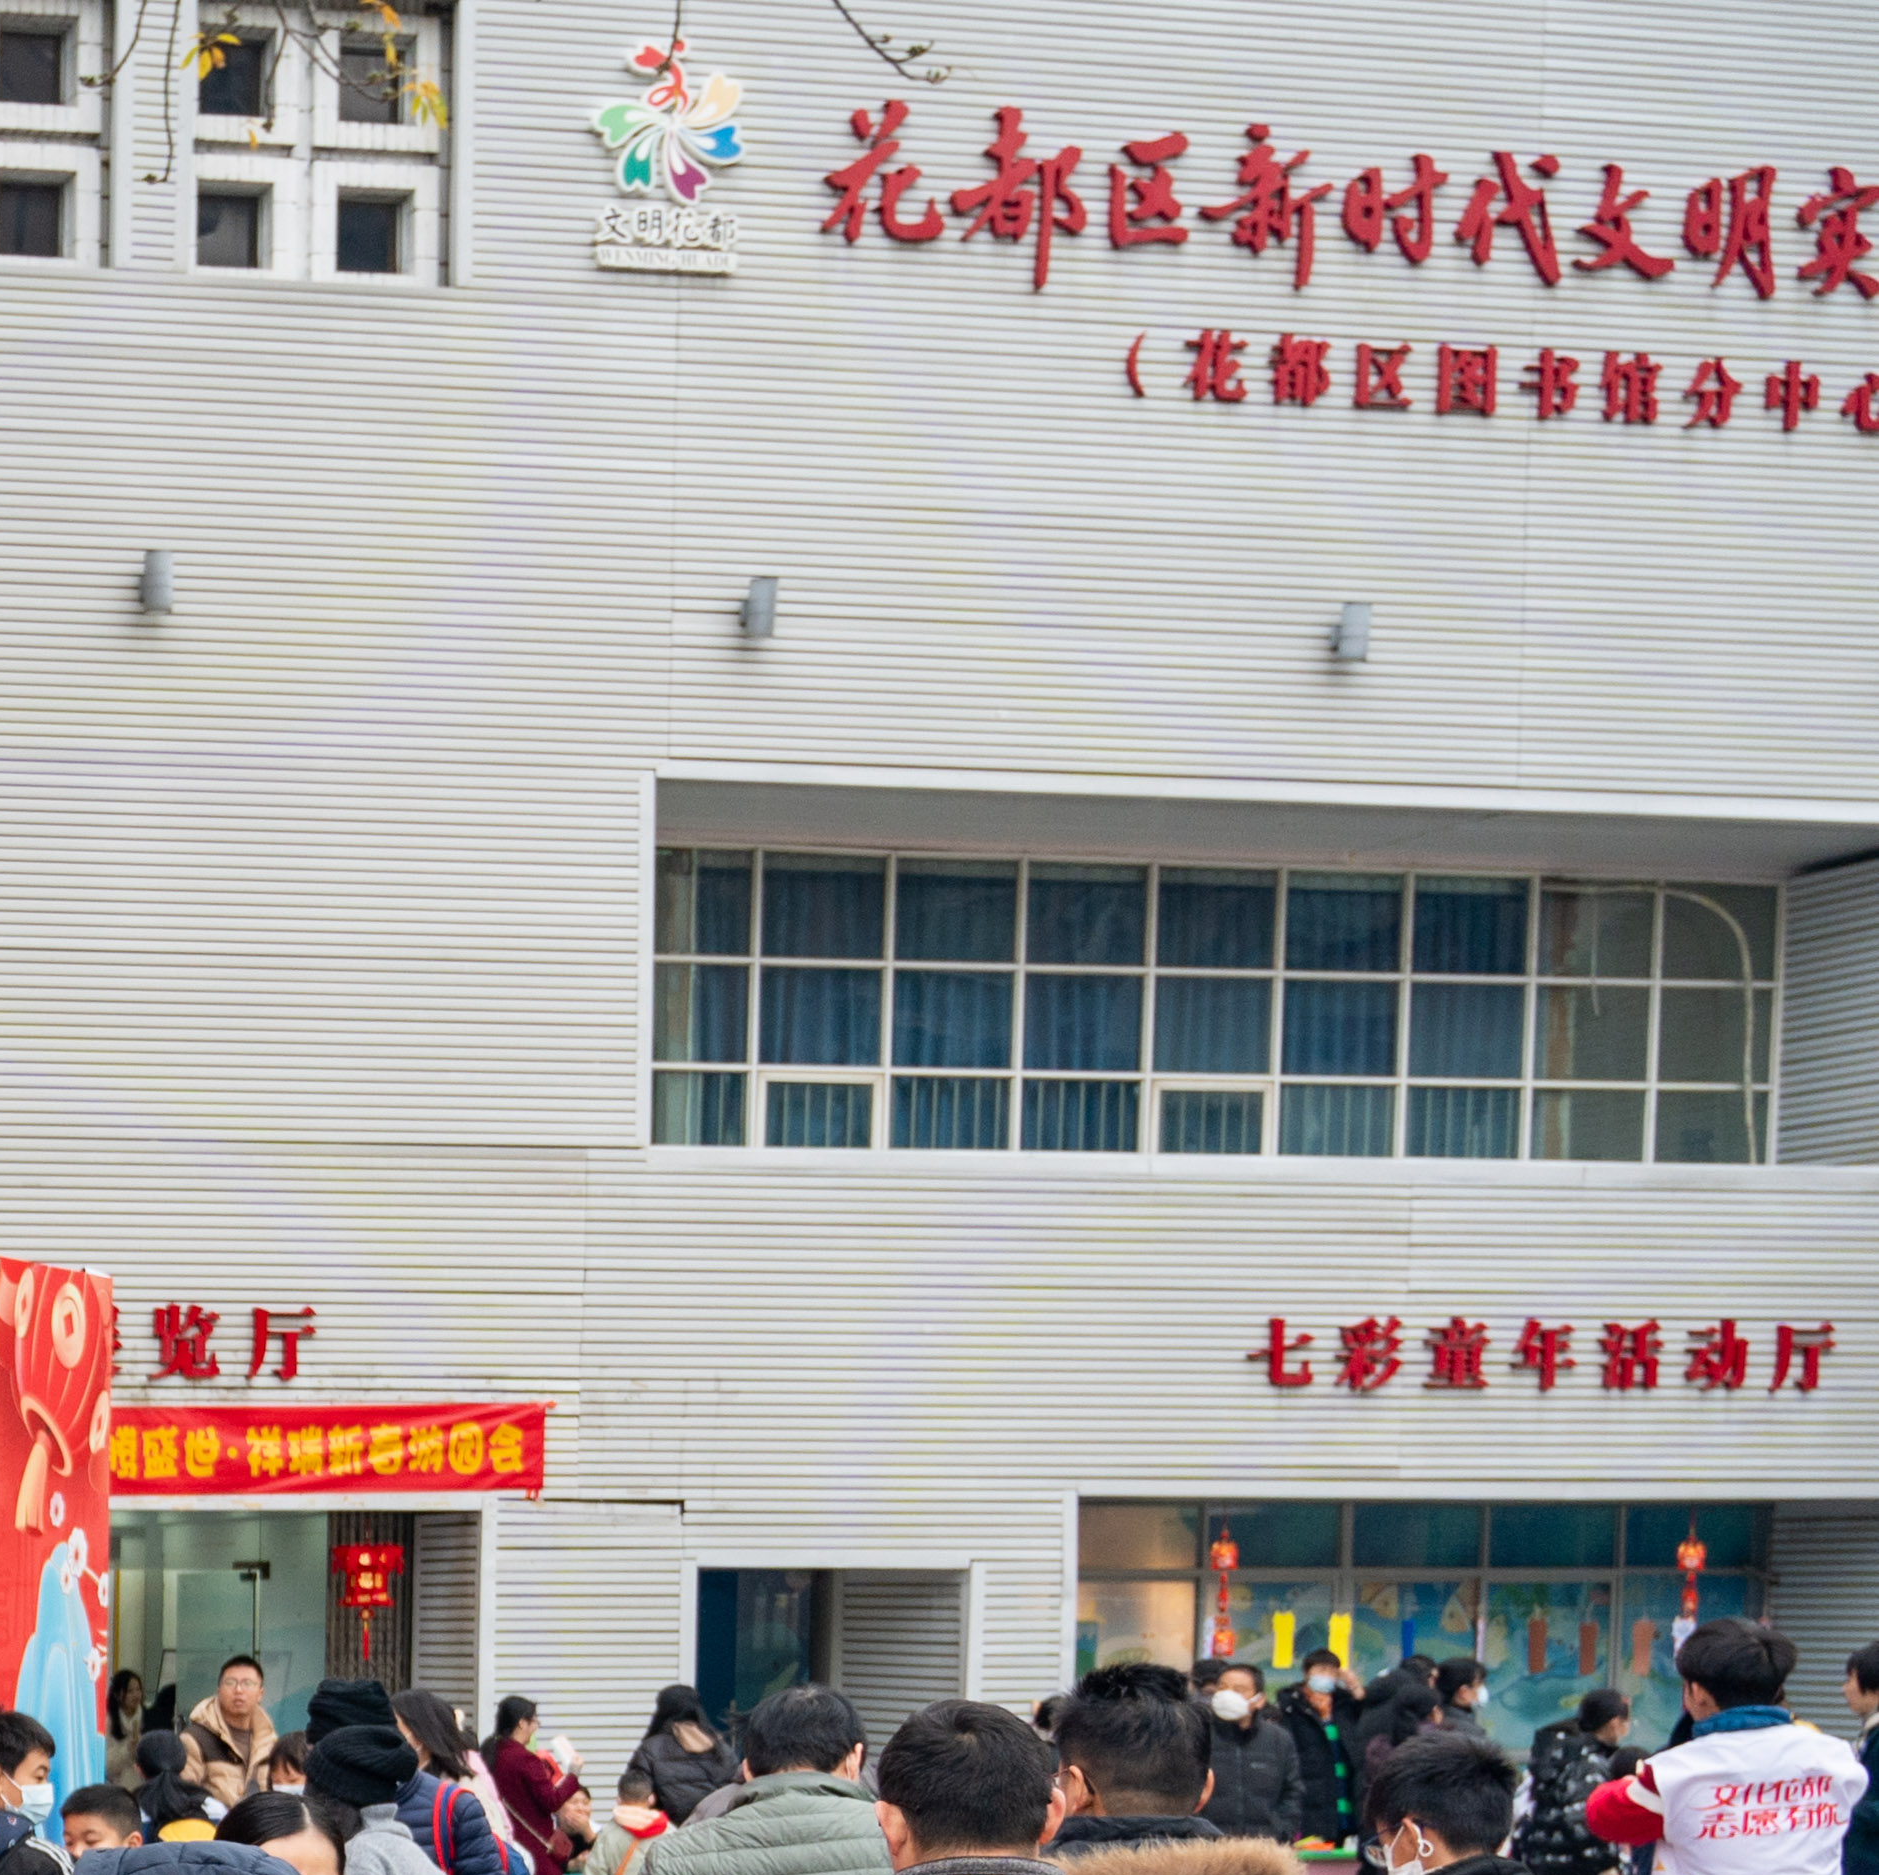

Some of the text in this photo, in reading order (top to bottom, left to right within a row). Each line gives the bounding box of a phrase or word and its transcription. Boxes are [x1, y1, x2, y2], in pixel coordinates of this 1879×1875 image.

[596, 206, 736, 246] 文明花都
[112, 1303, 317, 1381] 览厅
[1247, 1316, 1837, 1393] 七彩童年活动厅
